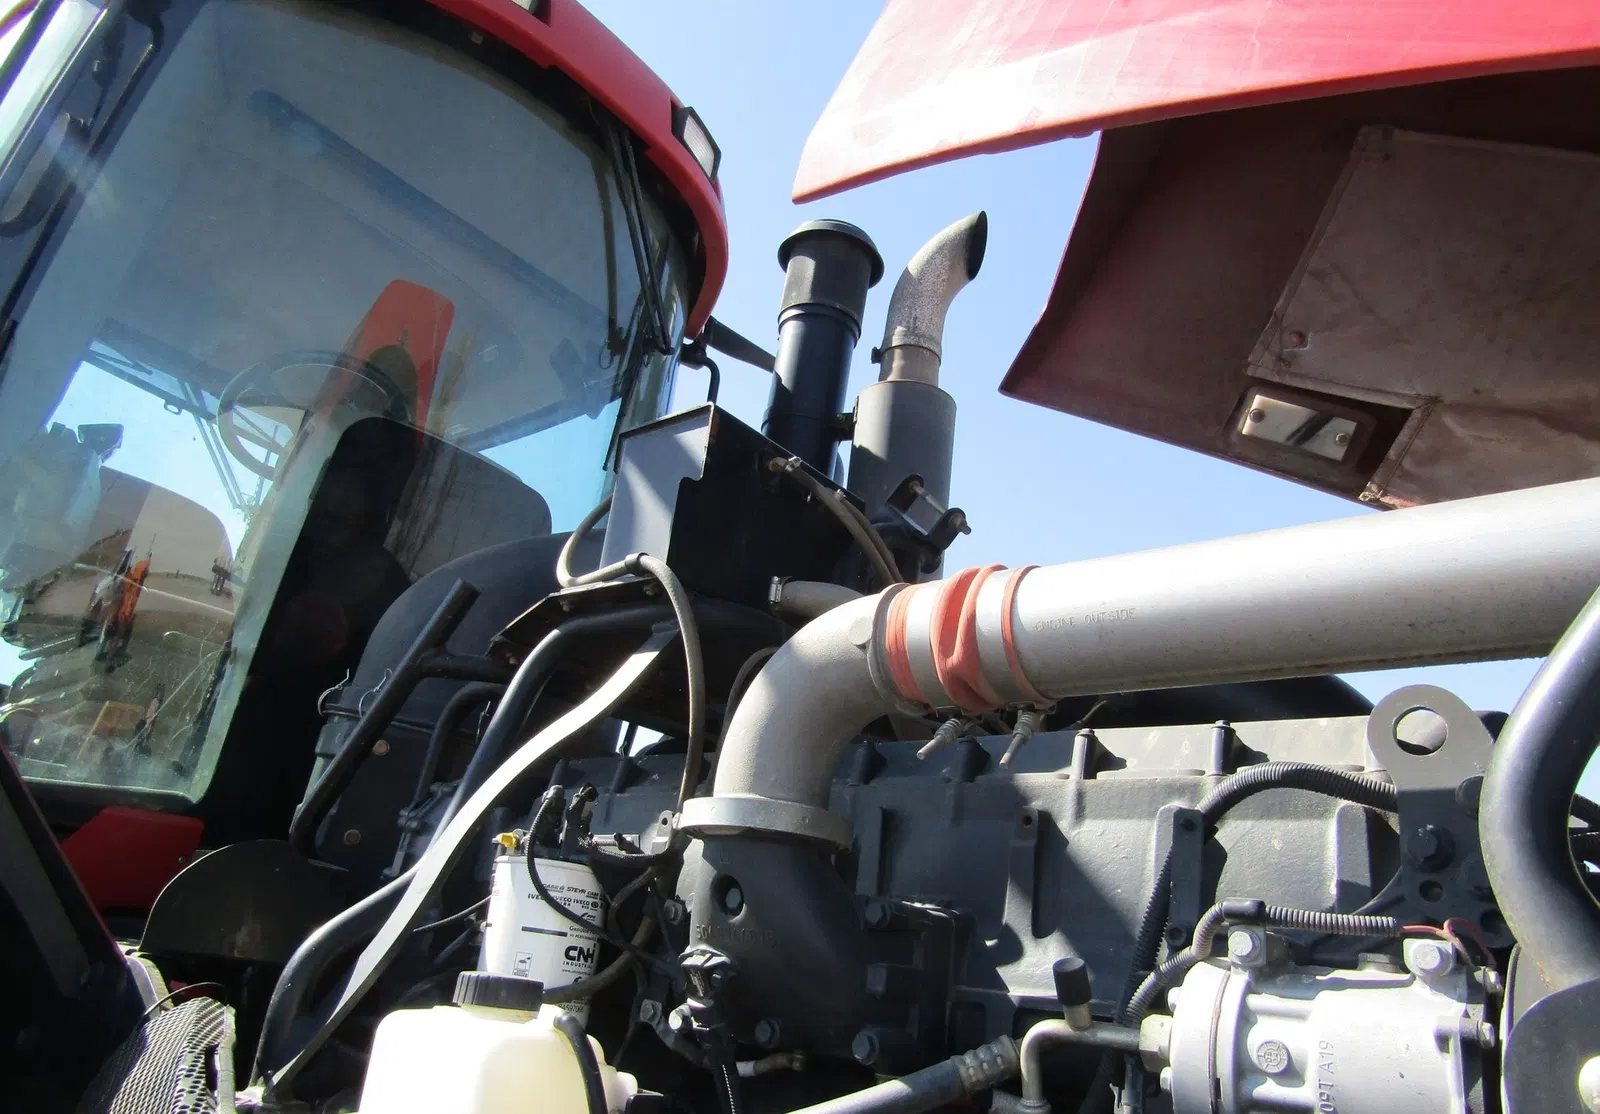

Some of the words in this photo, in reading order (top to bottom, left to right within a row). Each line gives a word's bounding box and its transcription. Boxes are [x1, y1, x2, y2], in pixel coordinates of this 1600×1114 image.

[1084, 607, 1137, 625] OUTSIDE
[566, 886, 587, 894] STEYR
[527, 893, 545, 901] IVEC
